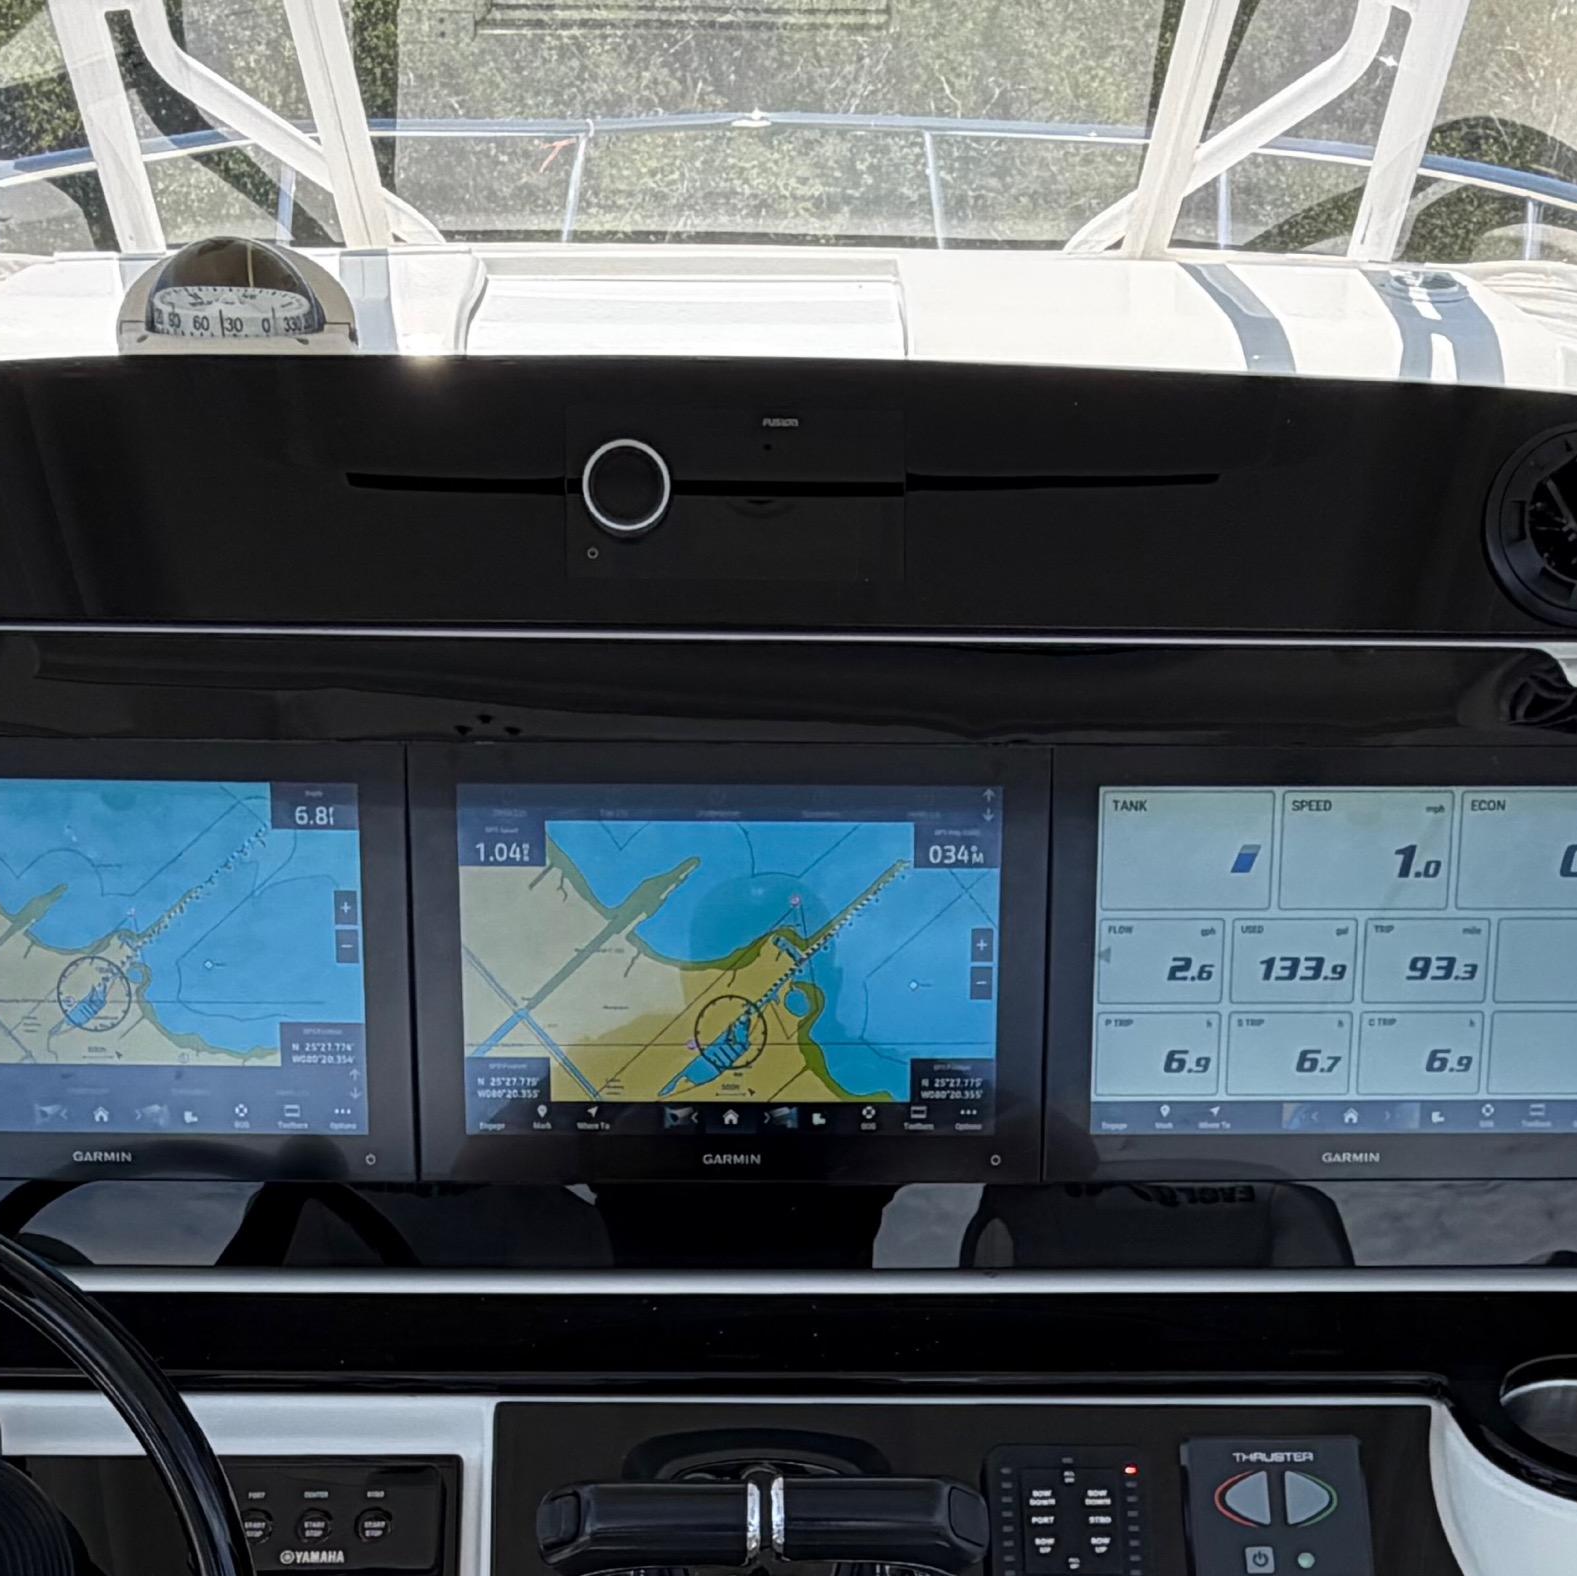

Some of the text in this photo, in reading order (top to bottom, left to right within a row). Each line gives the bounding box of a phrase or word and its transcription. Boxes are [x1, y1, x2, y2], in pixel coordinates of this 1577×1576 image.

[193, 315, 209, 331] 60
[225, 317, 243, 332] 30
[261, 318, 271, 332] 0
[762, 417, 799, 427] FUSION
[1113, 800, 1147, 812] TANK
[1292, 800, 1332, 812] SPEED
[1471, 800, 1506, 812] ECON
[1394, 844, 1442, 879] 1.0
[1108, 925, 1133, 935] FLOW
[1241, 925, 1264, 935] USED
[1167, 957, 1215, 982] 2.6
[1260, 956, 1347, 981] 133.9
[1405, 956, 1478, 981] 93.3
[1163, 1049, 1211, 1073] 6.9
[1295, 1049, 1342, 1073] 6.7
[1425, 1049, 1473, 1073] 6.9
[73, 1151, 132, 1162] GARMIN
[702, 1154, 761, 1164] GARMIN
[1322, 1152, 1380, 1163] GARMIN
[1232, 1452, 1314, 1463] THRUSTER
[1087, 1489, 1108, 1497] BOW
[1031, 1516, 1055, 1524] PORT
[1088, 1516, 1112, 1524] STBD
[1091, 1537, 1111, 1545] BOW
[295, 1550, 345, 1564] YAMAHA
